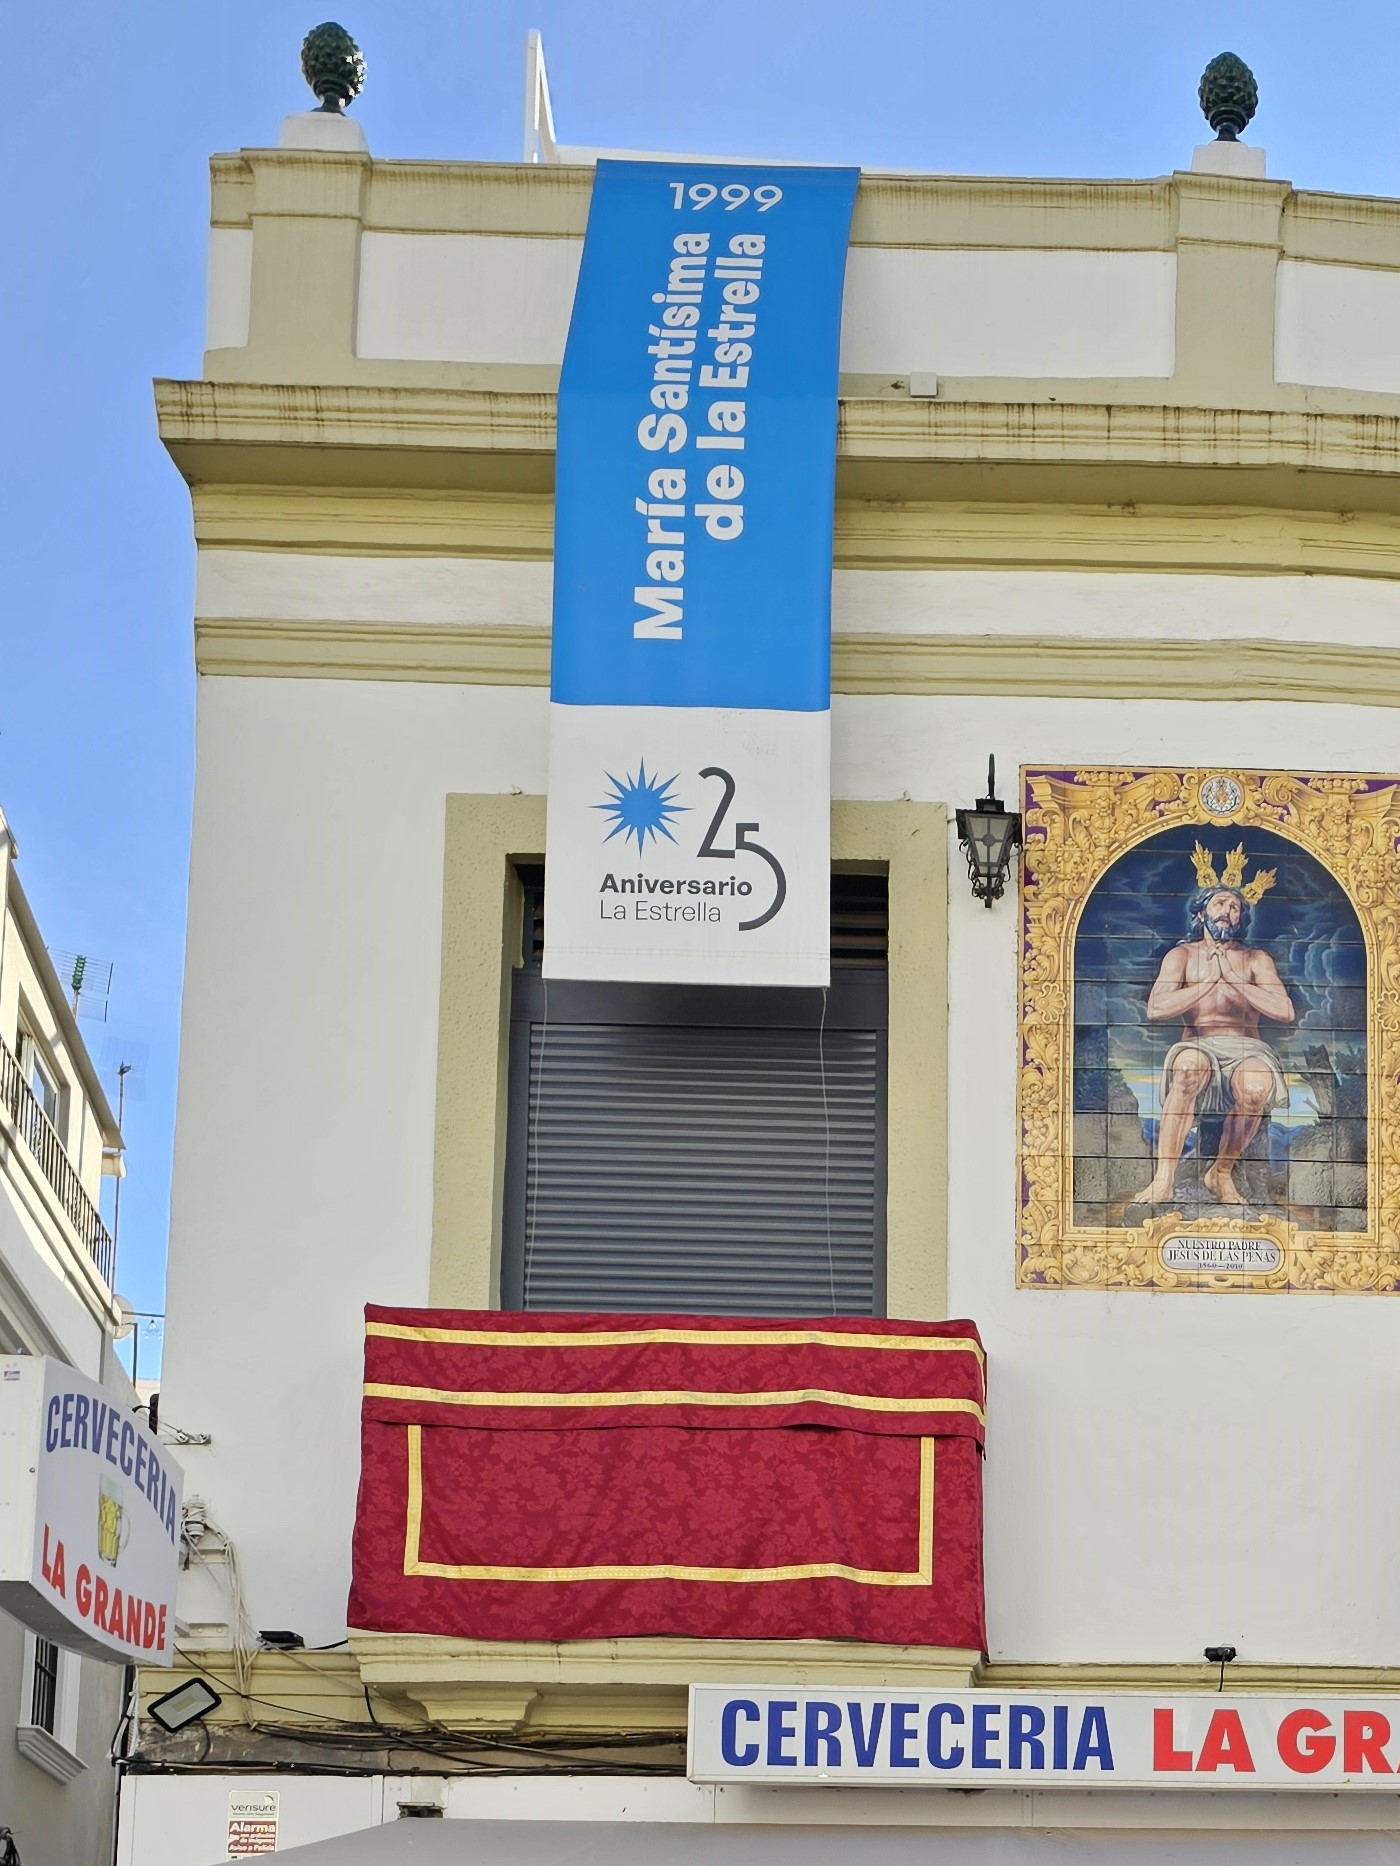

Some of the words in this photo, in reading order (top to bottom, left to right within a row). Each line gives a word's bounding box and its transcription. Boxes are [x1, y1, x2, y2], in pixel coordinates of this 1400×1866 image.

[669, 182, 784, 213] 1999
[638, 232, 712, 455] Santísima
[699, 233, 767, 389] Estrella
[696, 401, 747, 452] la
[694, 464, 746, 541] de
[633, 470, 688, 641] María
[599, 873, 753, 898] Aniversario
[696, 766, 788, 933] 25
[600, 900, 627, 923] La
[634, 900, 722, 924] Estrella
[1178, 1240, 1226, 1250] NUESTRO
[1228, 1241, 1262, 1250] PADRE
[1202, 1251, 1217, 1261] DE
[1219, 1251, 1240, 1262] LAS
[1243, 1252, 1276, 1263] PENAS
[46, 1393, 177, 1546] CERVECERIA
[41, 1523, 67, 1600] LA
[75, 1563, 168, 1651] GRANDE
[721, 1699, 1114, 1771] CERVECERIA
[1153, 1708, 1256, 1774] LA
[230, 1821, 276, 1832] Alarma
